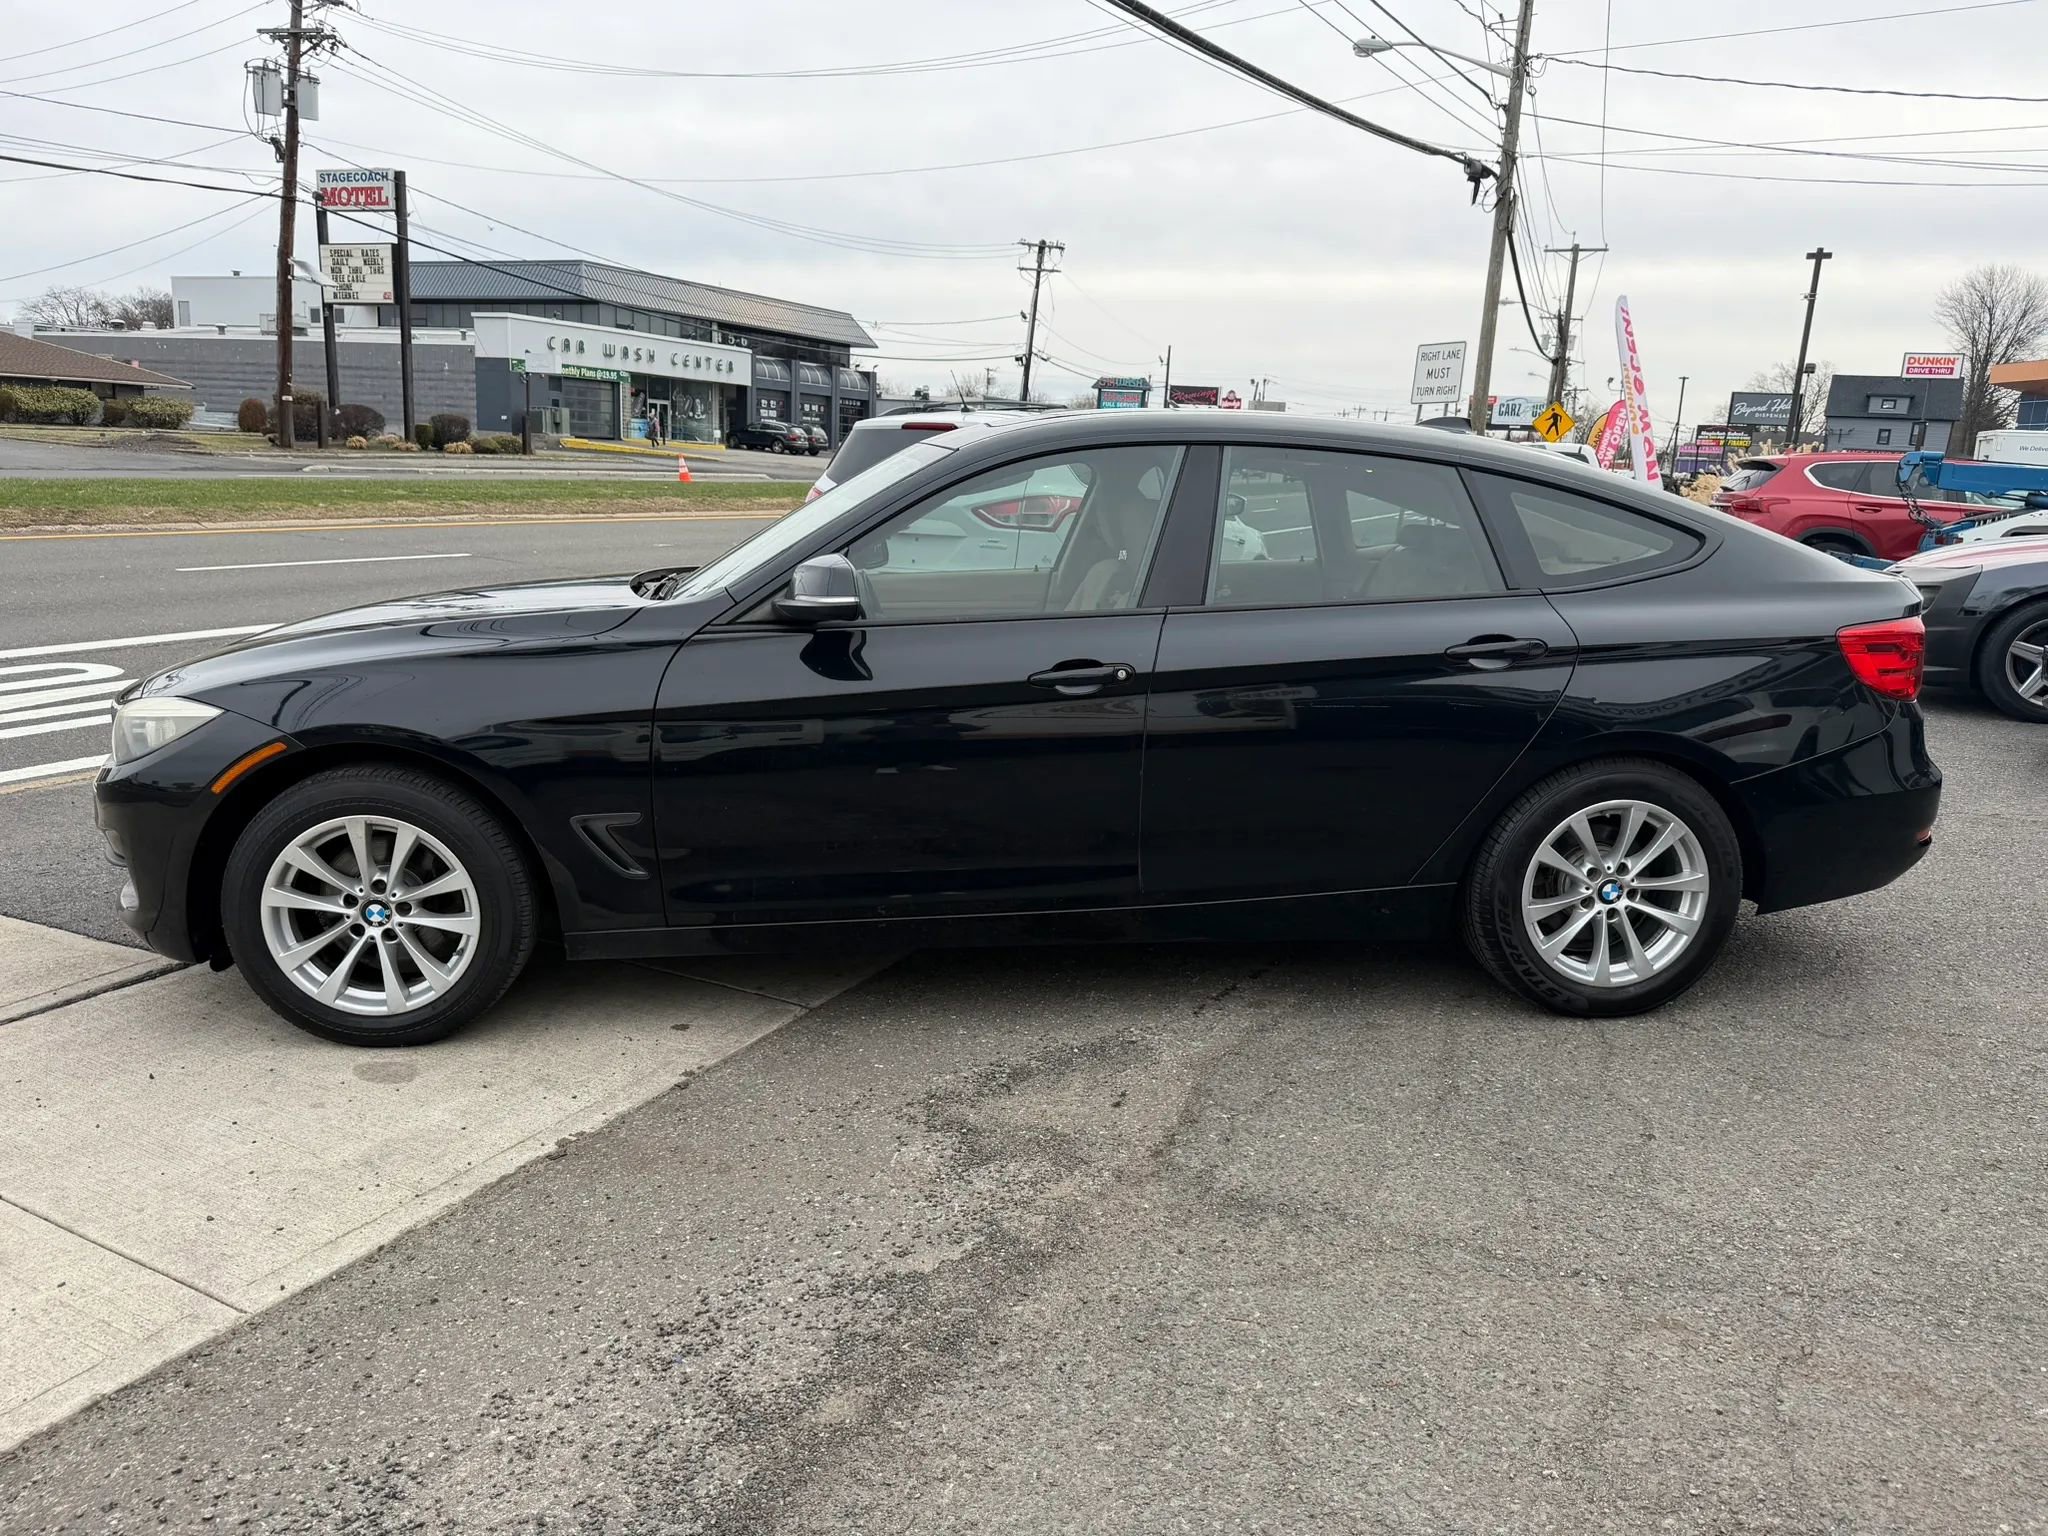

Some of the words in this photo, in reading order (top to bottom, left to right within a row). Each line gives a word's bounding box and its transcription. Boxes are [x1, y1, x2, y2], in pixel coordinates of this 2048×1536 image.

[320, 171, 389, 183] STAGECOACH
[321, 186, 389, 207] MOTEL
[329, 249, 353, 257] SPECIAL
[361, 249, 380, 257] RATES
[331, 258, 349, 266] DAILY
[363, 258, 384, 266] WEEKLY
[330, 266, 342, 274] MON
[348, 266, 362, 274] THRU
[347, 275, 366, 283] CABLE
[547, 336, 585, 354] CAR
[602, 343, 656, 363] WASH
[670, 352, 735, 373] CENTER
[1420, 350, 1440, 361] RIGHT
[1442, 349, 1461, 360] LANE
[561, 366, 581, 379] onthly
[581, 367, 597, 378] Plans
[1426, 367, 1451, 380] MUST
[1416, 386, 1435, 396] TURN
[1435, 385, 1457, 395] RIGHT
[1498, 403, 1522, 417] CARZ
[1600, 446, 1616, 470] OW
[1610, 407, 1628, 445] OPEN
